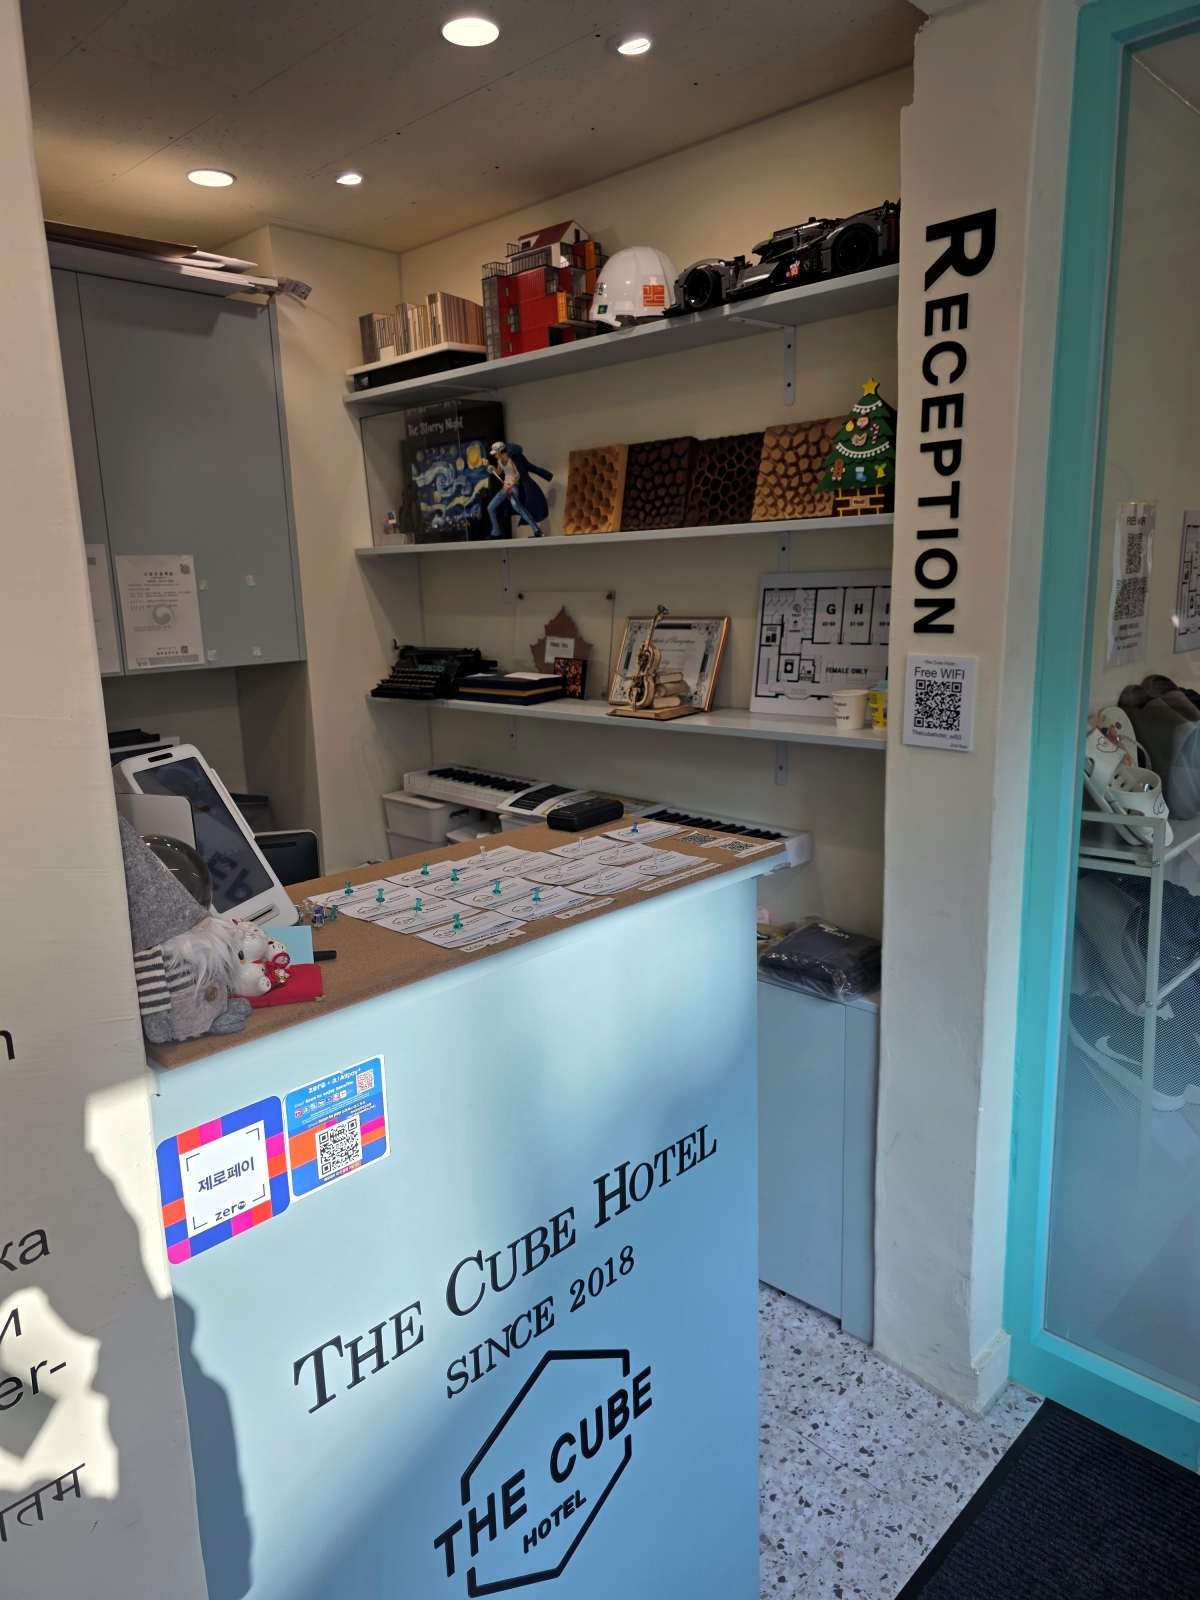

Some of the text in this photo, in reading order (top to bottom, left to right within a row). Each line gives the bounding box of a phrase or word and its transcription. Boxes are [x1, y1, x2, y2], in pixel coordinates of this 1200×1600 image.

[407, 415, 464, 437] The Starry Night
[913, 208, 997, 633] RECEPTION
[826, 603, 836, 615] G
[854, 603, 864, 615] H
[825, 666, 850, 674] FEMALE
[914, 666, 965, 680] Free WIFI
[197, 1156, 256, 1193] 제로페이
[293, 1124, 717, 1414] THE CUBE HOTEL
[446, 1245, 636, 1399] SINCE 2018
[433, 1366, 653, 1578] THE CUBE
[523, 1489, 587, 1554] HOTEL
